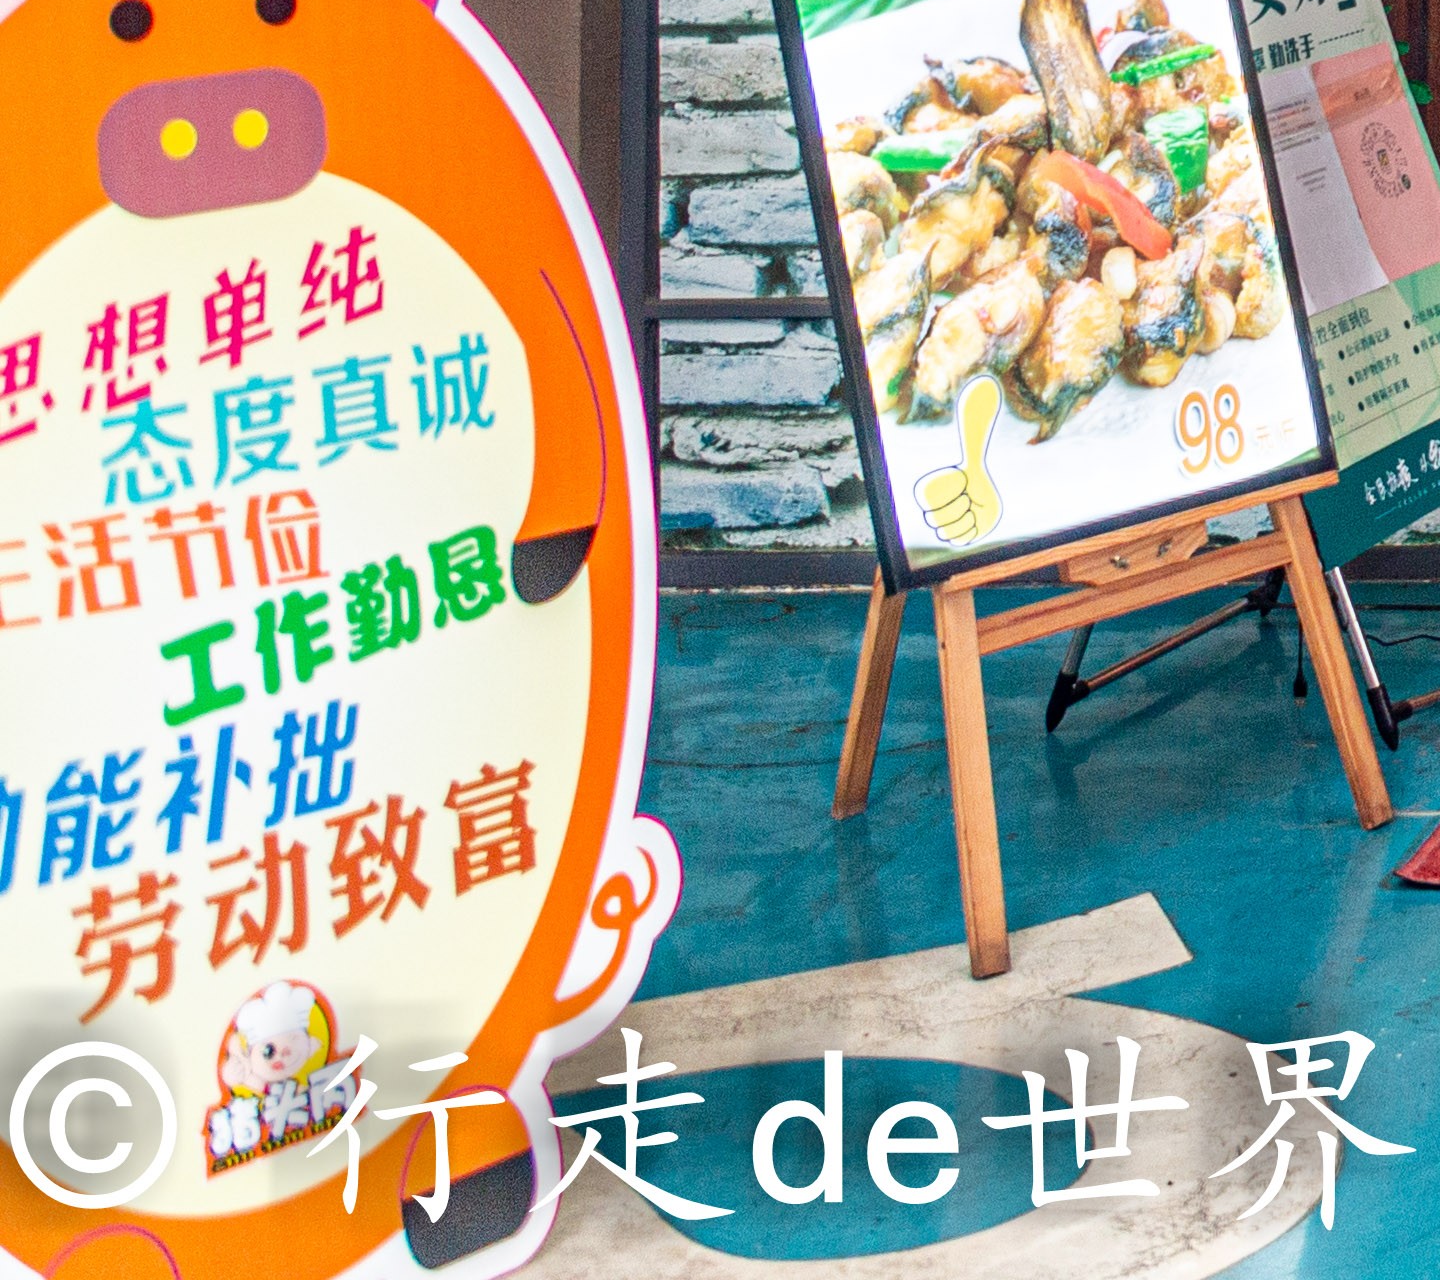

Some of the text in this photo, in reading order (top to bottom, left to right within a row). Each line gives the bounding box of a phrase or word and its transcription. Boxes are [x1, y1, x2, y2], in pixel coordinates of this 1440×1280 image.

[1269, 33, 1315, 69] 勤洗手
[0, 225, 386, 441] 思想单纯
[101, 333, 497, 507] 态度真诚
[1180, 383, 1244, 474] 98
[161, 524, 507, 727] 工作勤恳
[0, 699, 359, 895] 能补拙
[72, 760, 537, 1025] 劳动致富
